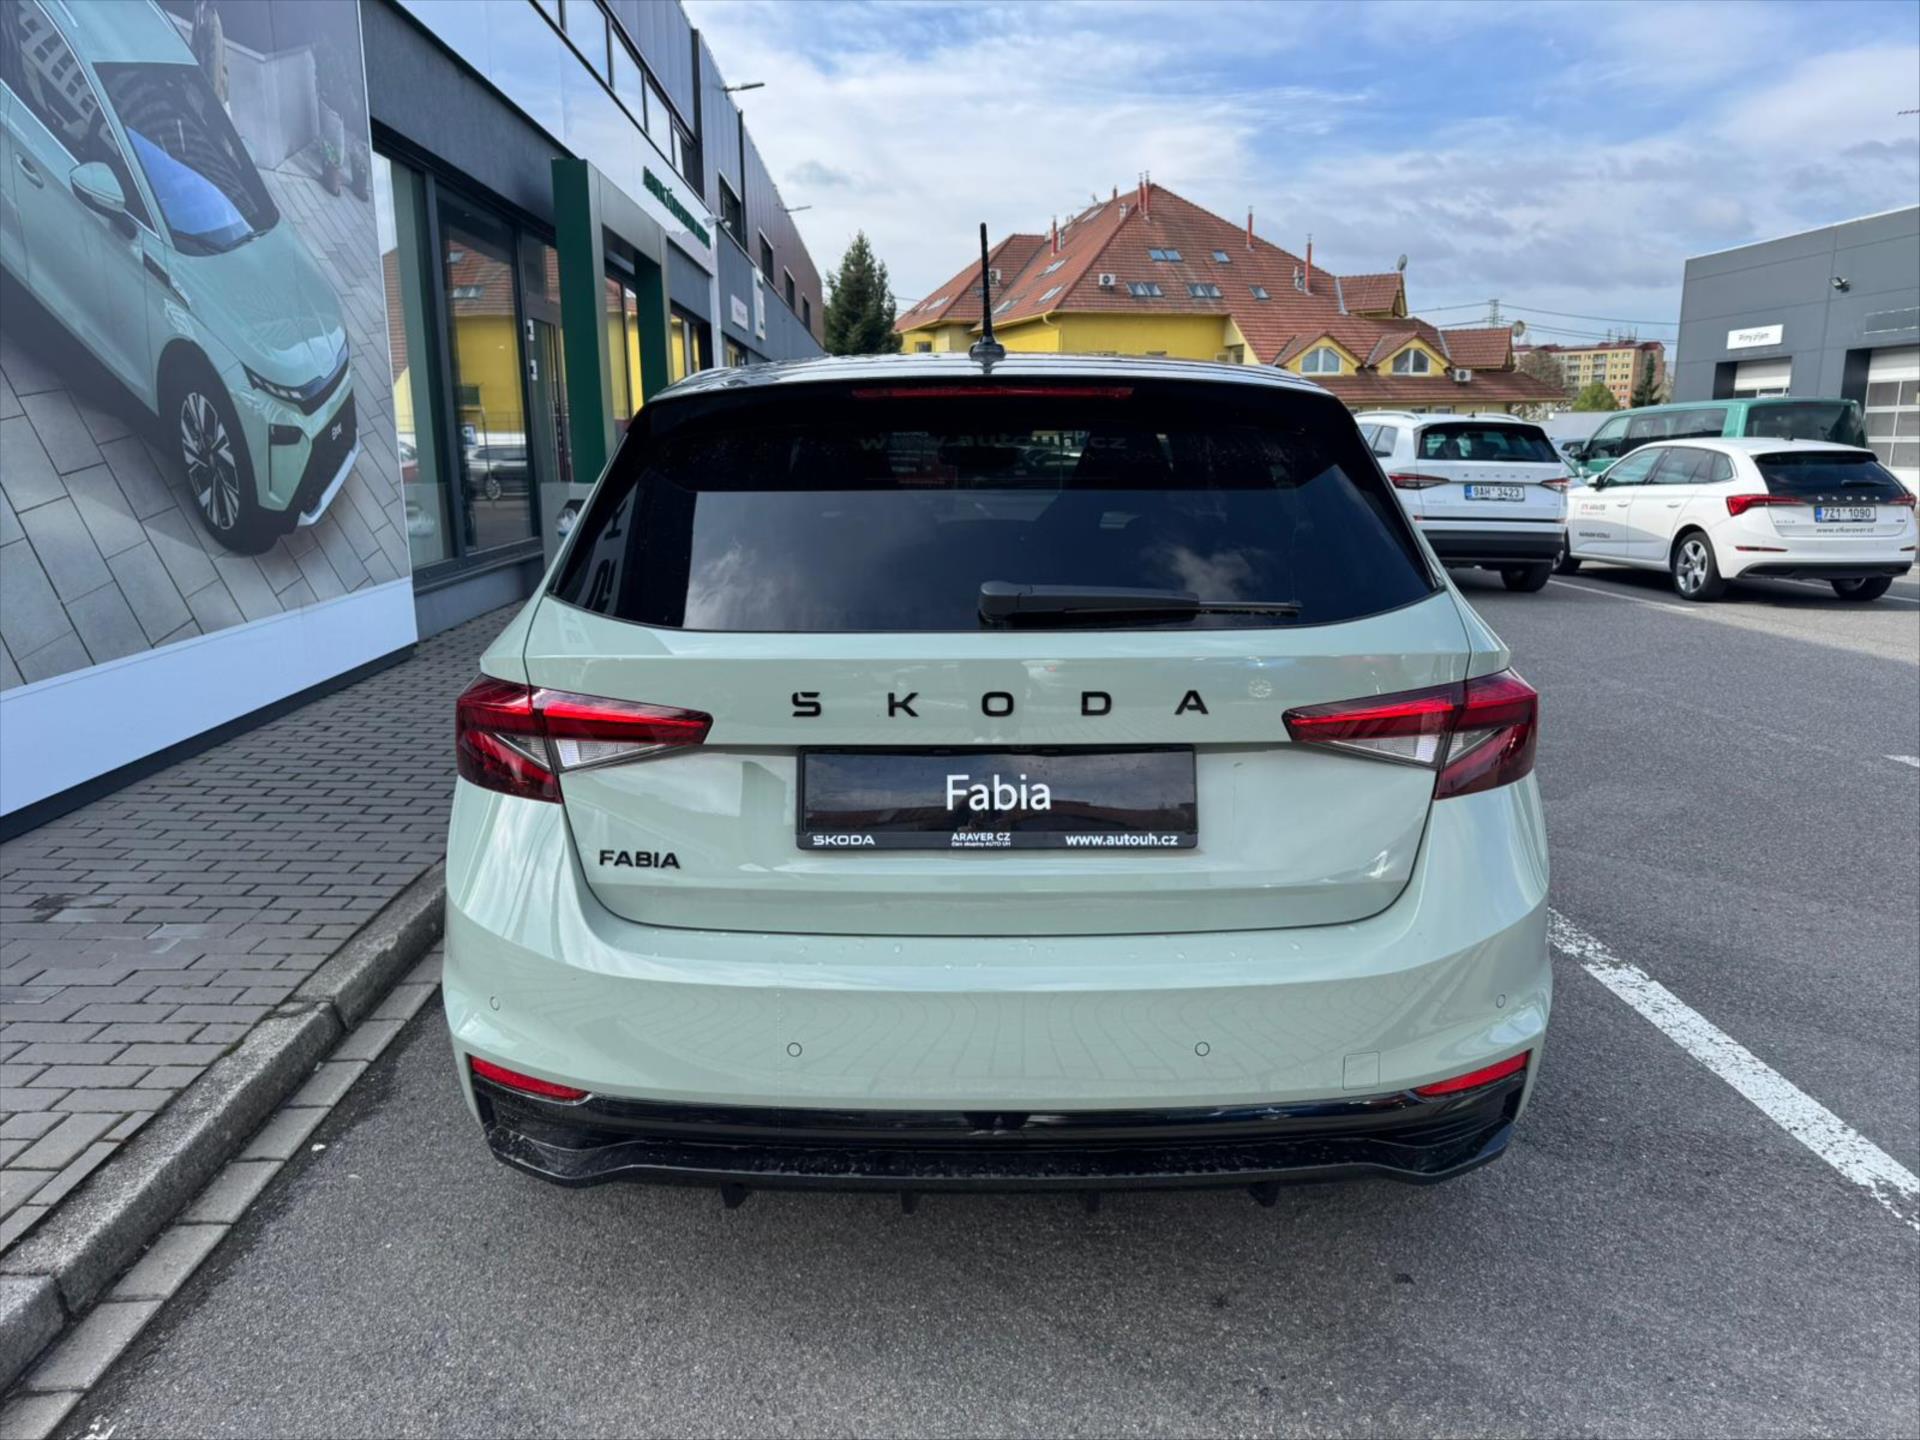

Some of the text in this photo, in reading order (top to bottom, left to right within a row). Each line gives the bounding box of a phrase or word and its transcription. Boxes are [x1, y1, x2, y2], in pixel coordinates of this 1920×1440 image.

[1473, 485, 1521, 498] 9AH 3423
[1823, 508, 1871, 518] 7Z1 1090
[791, 690, 1209, 717] SKODA
[946, 774, 1052, 811] Fabia
[812, 835, 876, 846] SKODA
[952, 832, 1011, 841] ARAVER CZ
[1065, 832, 1178, 846] www.autouh.cz
[599, 850, 681, 869] FABIA
